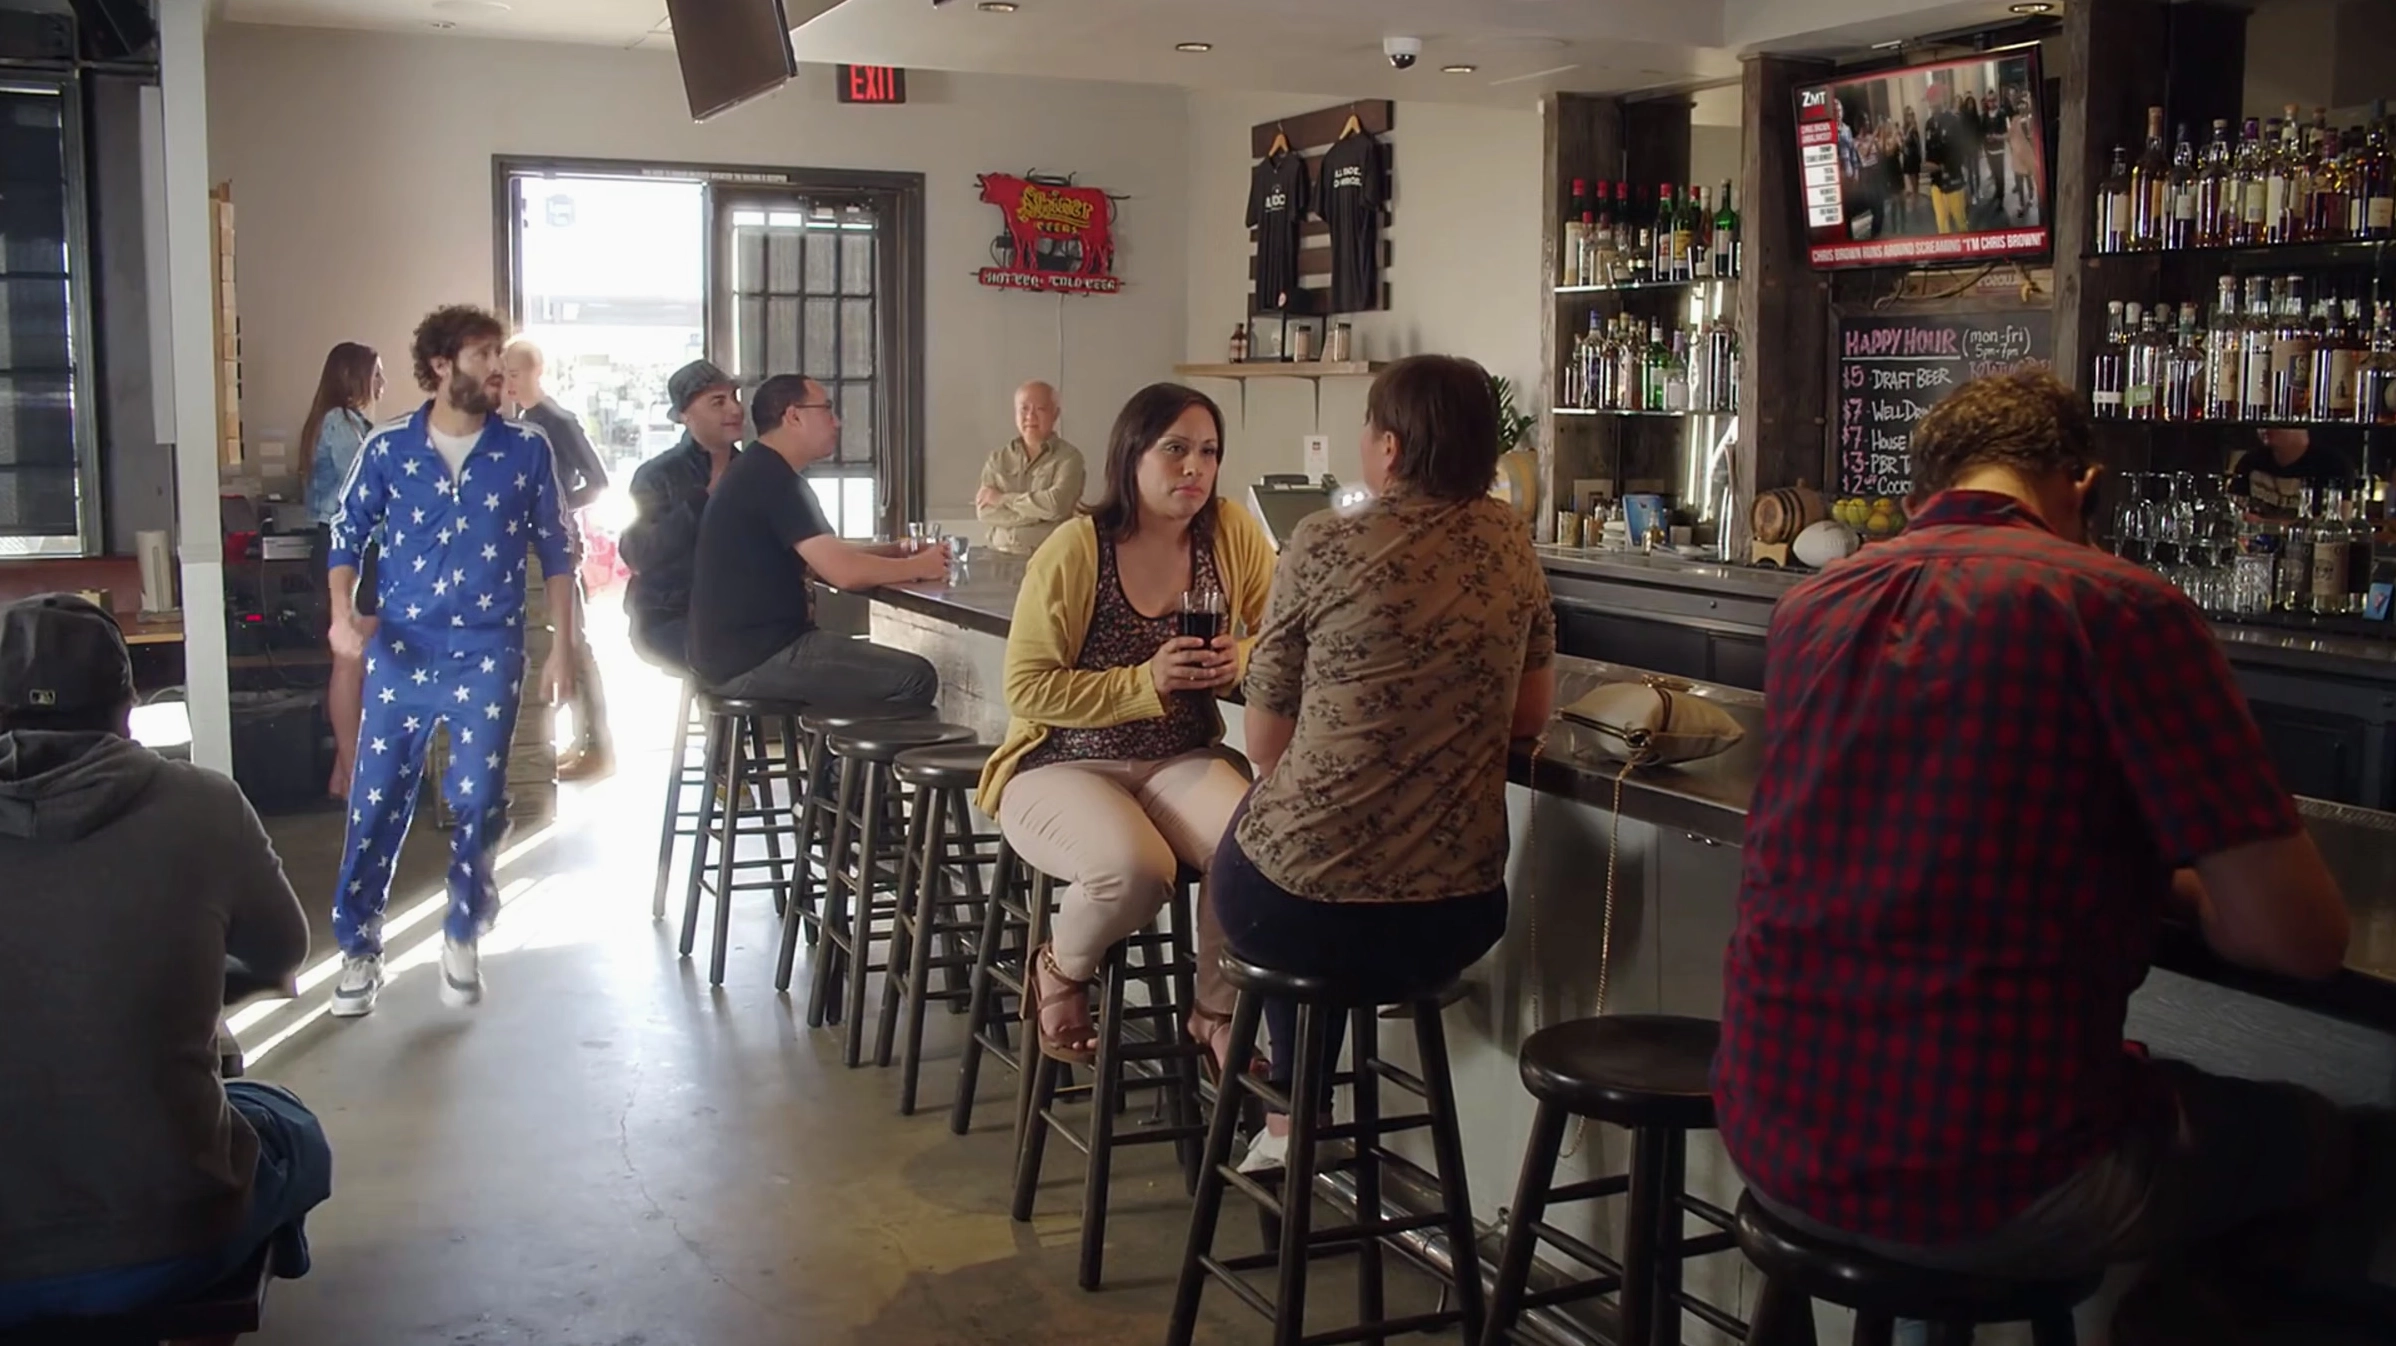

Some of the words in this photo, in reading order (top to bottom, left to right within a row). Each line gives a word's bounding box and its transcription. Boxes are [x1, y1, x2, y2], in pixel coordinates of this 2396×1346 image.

[850, 65, 895, 100] EXIT
[1802, 91, 1826, 107] ZMT
[1914, 238, 1961, 255] SCREAMING
[1981, 233, 2006, 250] CHRIS
[1845, 327, 1902, 356] HAPPY
[1903, 326, 1959, 355] HOUR
[1843, 365, 1865, 391] $5
[1871, 368, 1916, 390] DRAFT
[1916, 367, 1953, 389] BEER
[1871, 428, 1907, 451] HOUSE
[1870, 453, 1899, 475] PBR
